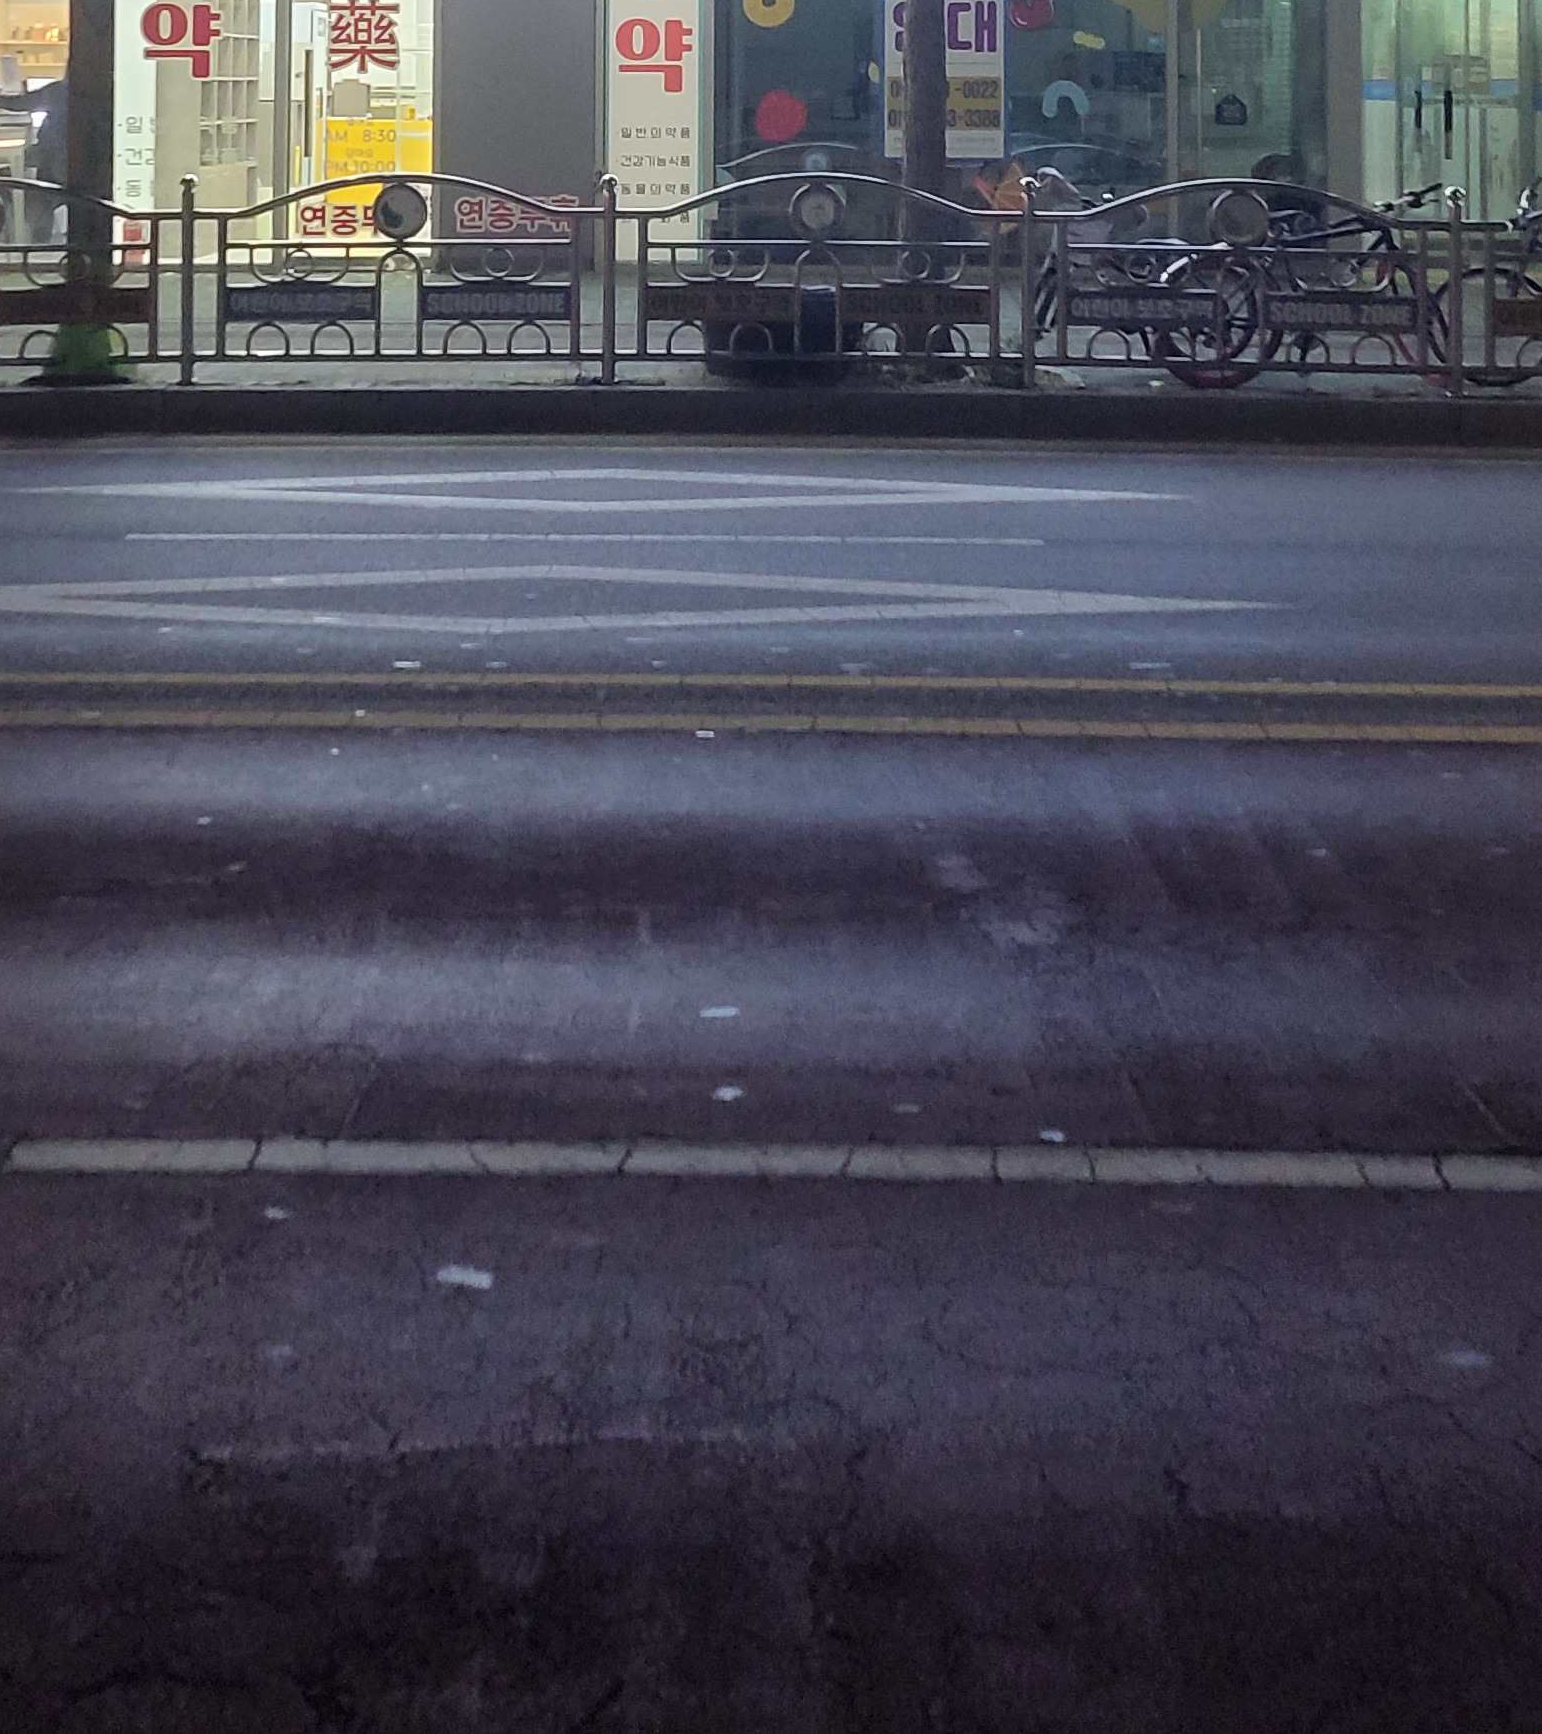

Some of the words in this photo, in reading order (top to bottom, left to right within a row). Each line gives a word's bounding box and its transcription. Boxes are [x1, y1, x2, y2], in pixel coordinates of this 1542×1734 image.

[141, 2, 223, 79] 약
[615, 17, 694, 93] 약
[362, 129, 397, 142] 8:30
